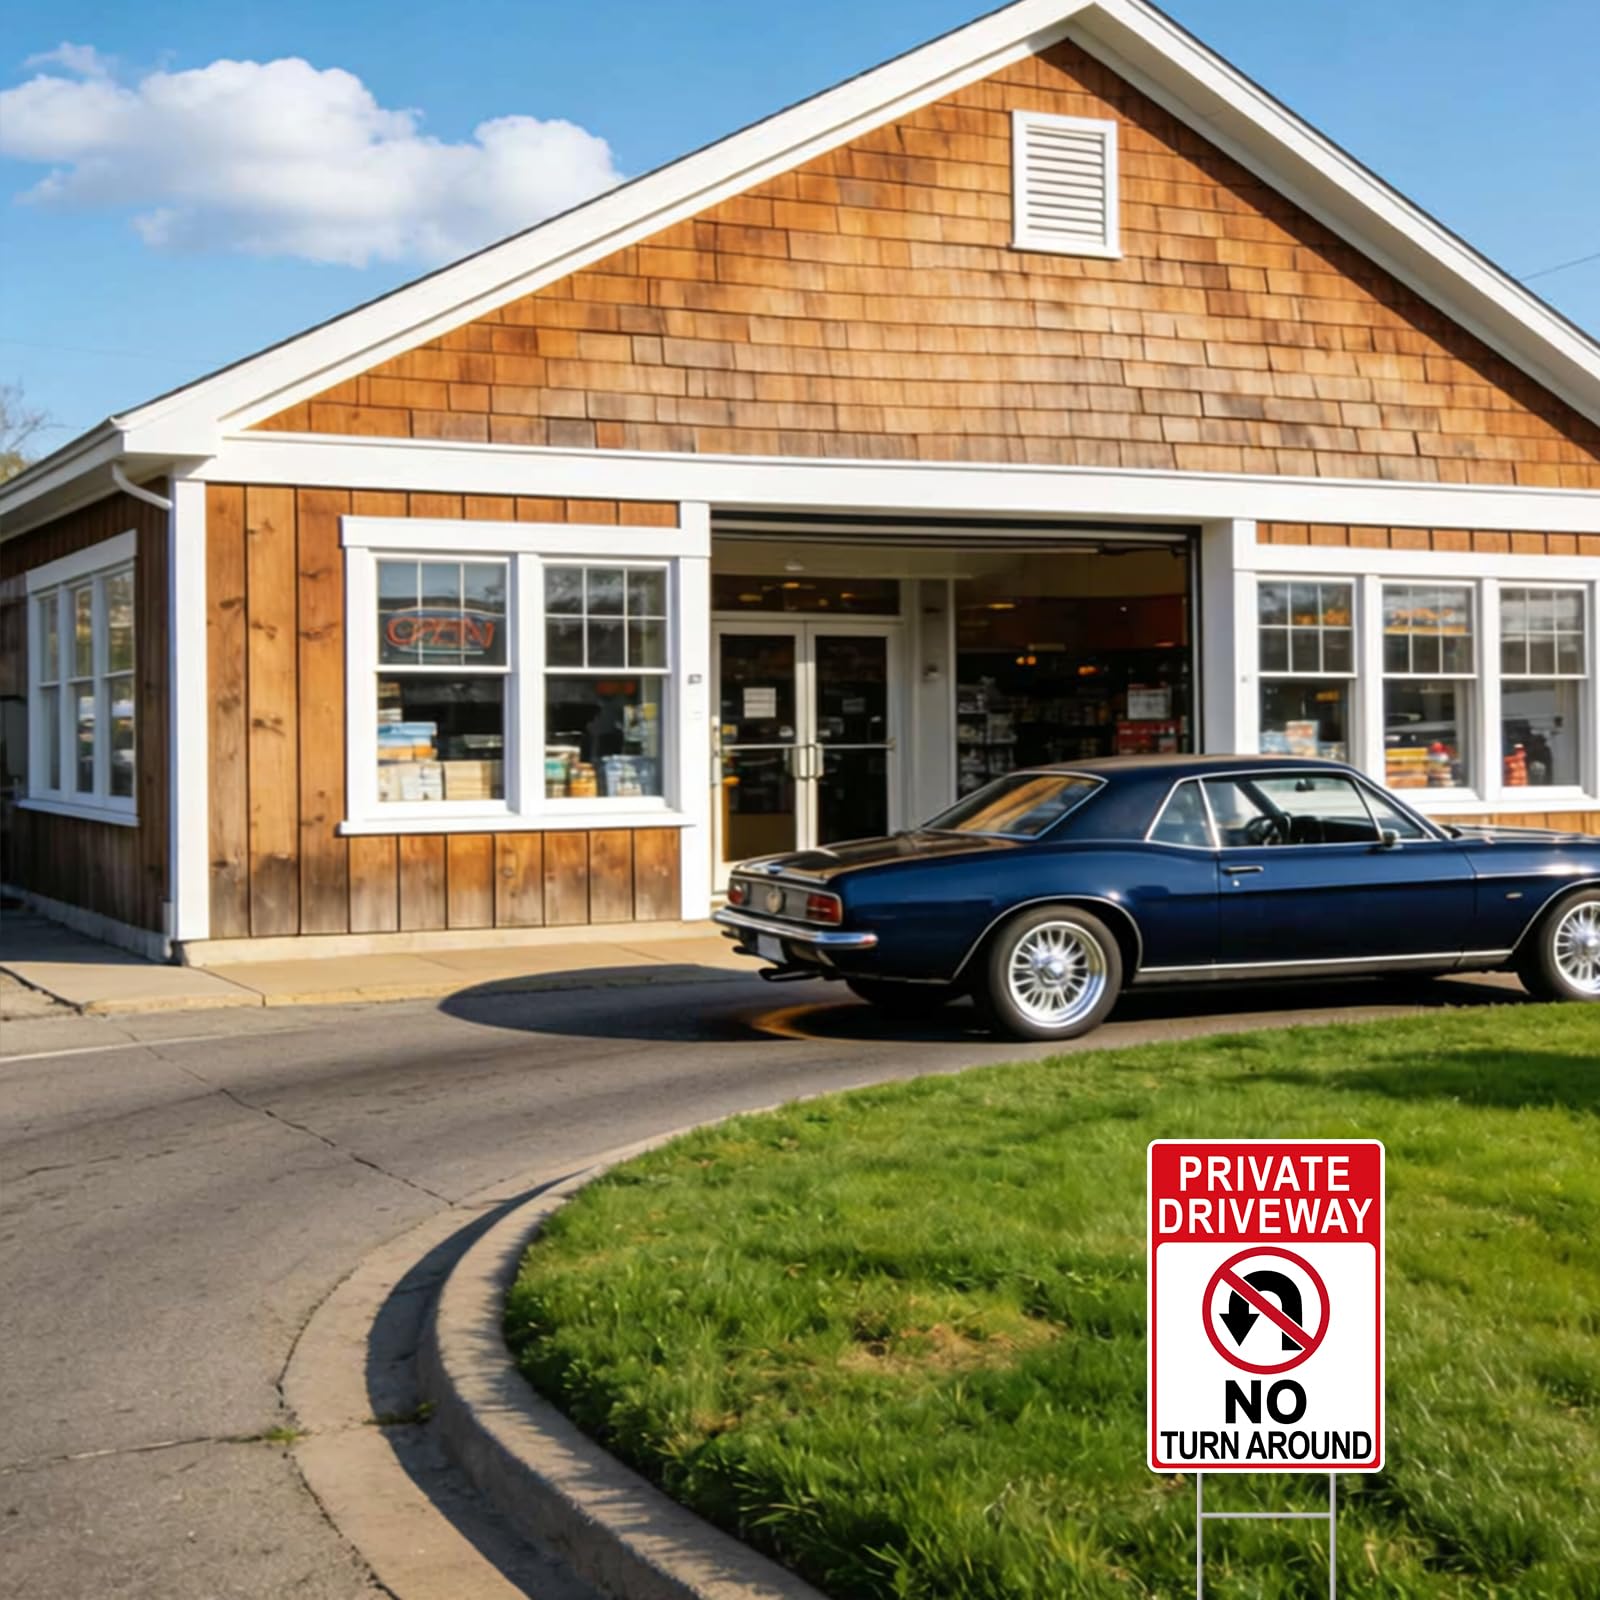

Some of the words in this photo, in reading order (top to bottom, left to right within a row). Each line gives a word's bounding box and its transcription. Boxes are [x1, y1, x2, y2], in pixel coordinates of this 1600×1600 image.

[1179, 1156, 1350, 1192] PRIVATE
[1158, 1198, 1373, 1234] DRIVEWAY
[1225, 1379, 1307, 1425] NO
[1160, 1431, 1240, 1460] TURN
[1245, 1431, 1372, 1460] AROUND
